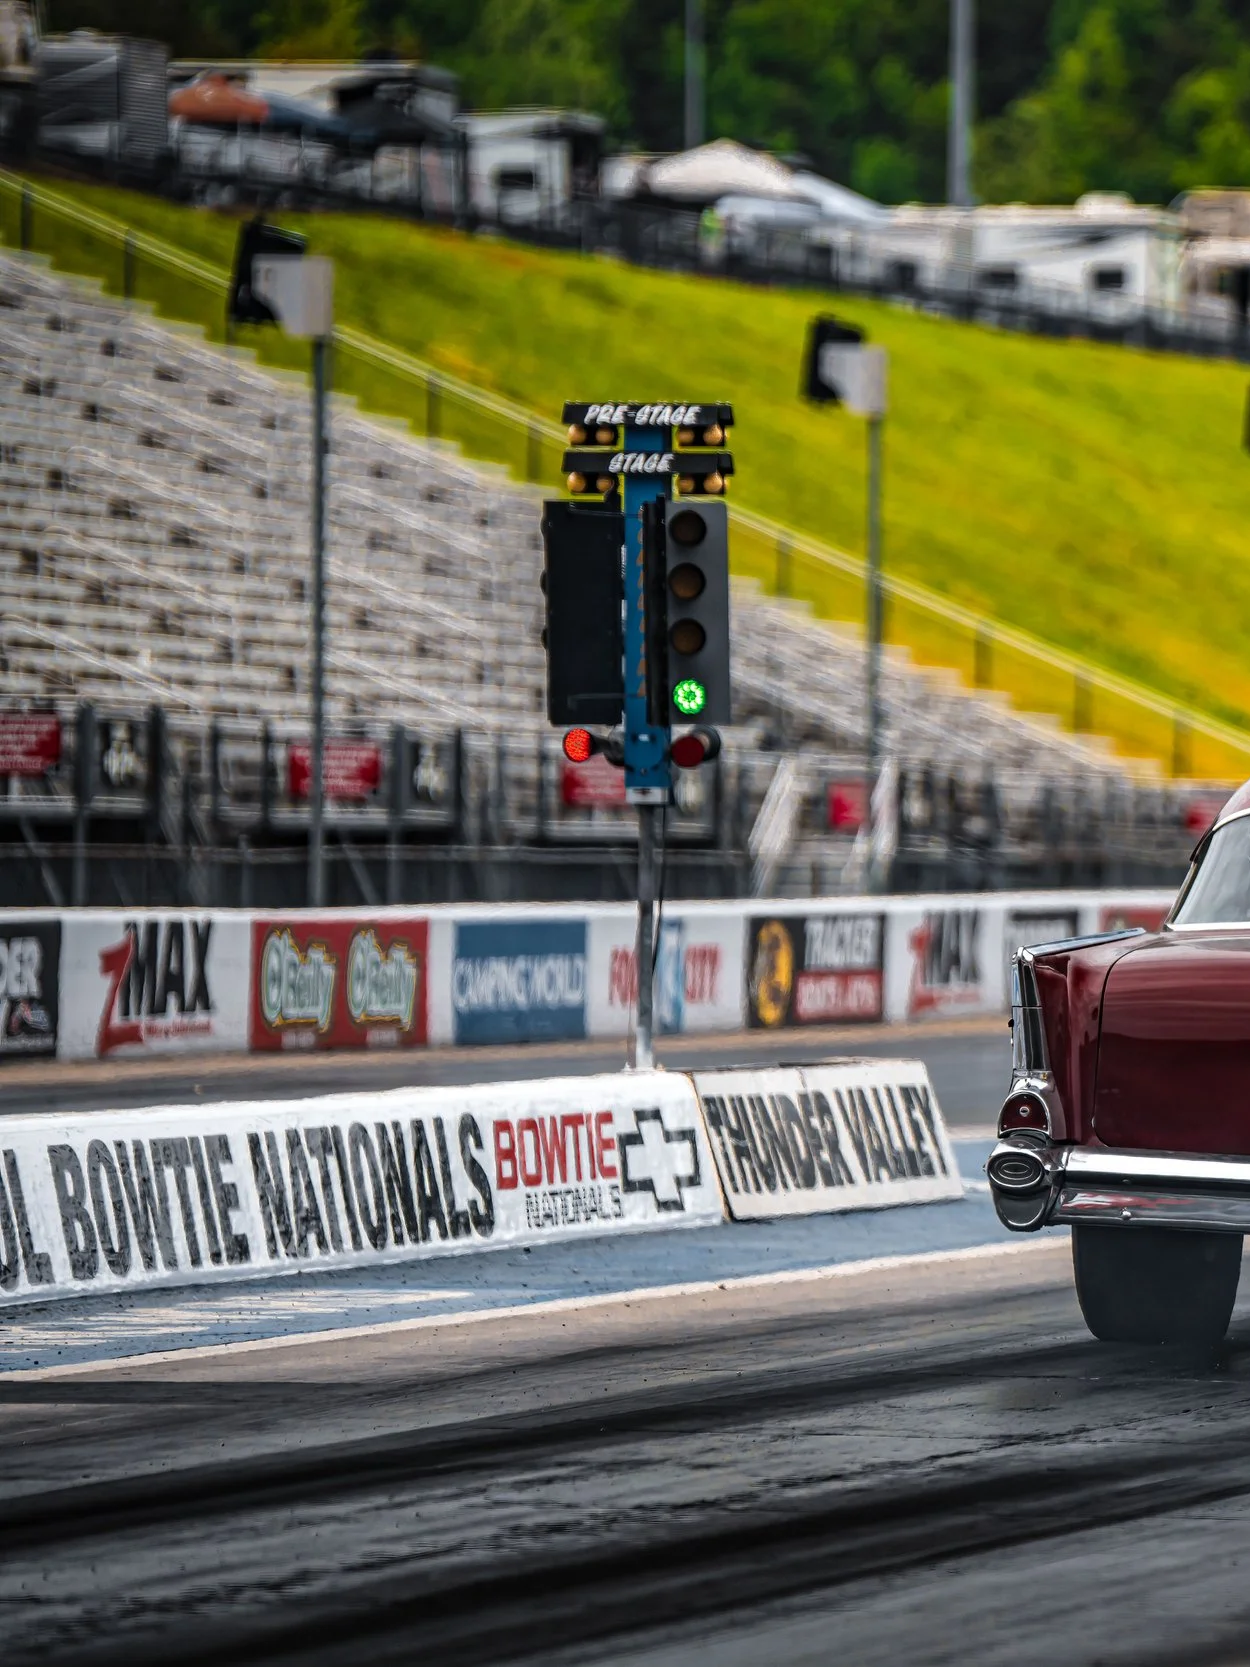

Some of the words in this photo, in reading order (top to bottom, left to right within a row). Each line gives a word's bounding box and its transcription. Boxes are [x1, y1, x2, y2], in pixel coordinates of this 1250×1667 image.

[584, 404, 702, 425] PRE-STAGE
[608, 452, 675, 473] STAGE
[493, 1110, 620, 1190] BOWTIE
[701, 1089, 855, 1194] THUNDER
[832, 1084, 948, 1184] VALLEY
[47, 1133, 250, 1281] BOWTIE
[246, 1113, 495, 1260] NATIONALS
[525, 1184, 624, 1228] NATIONALS
